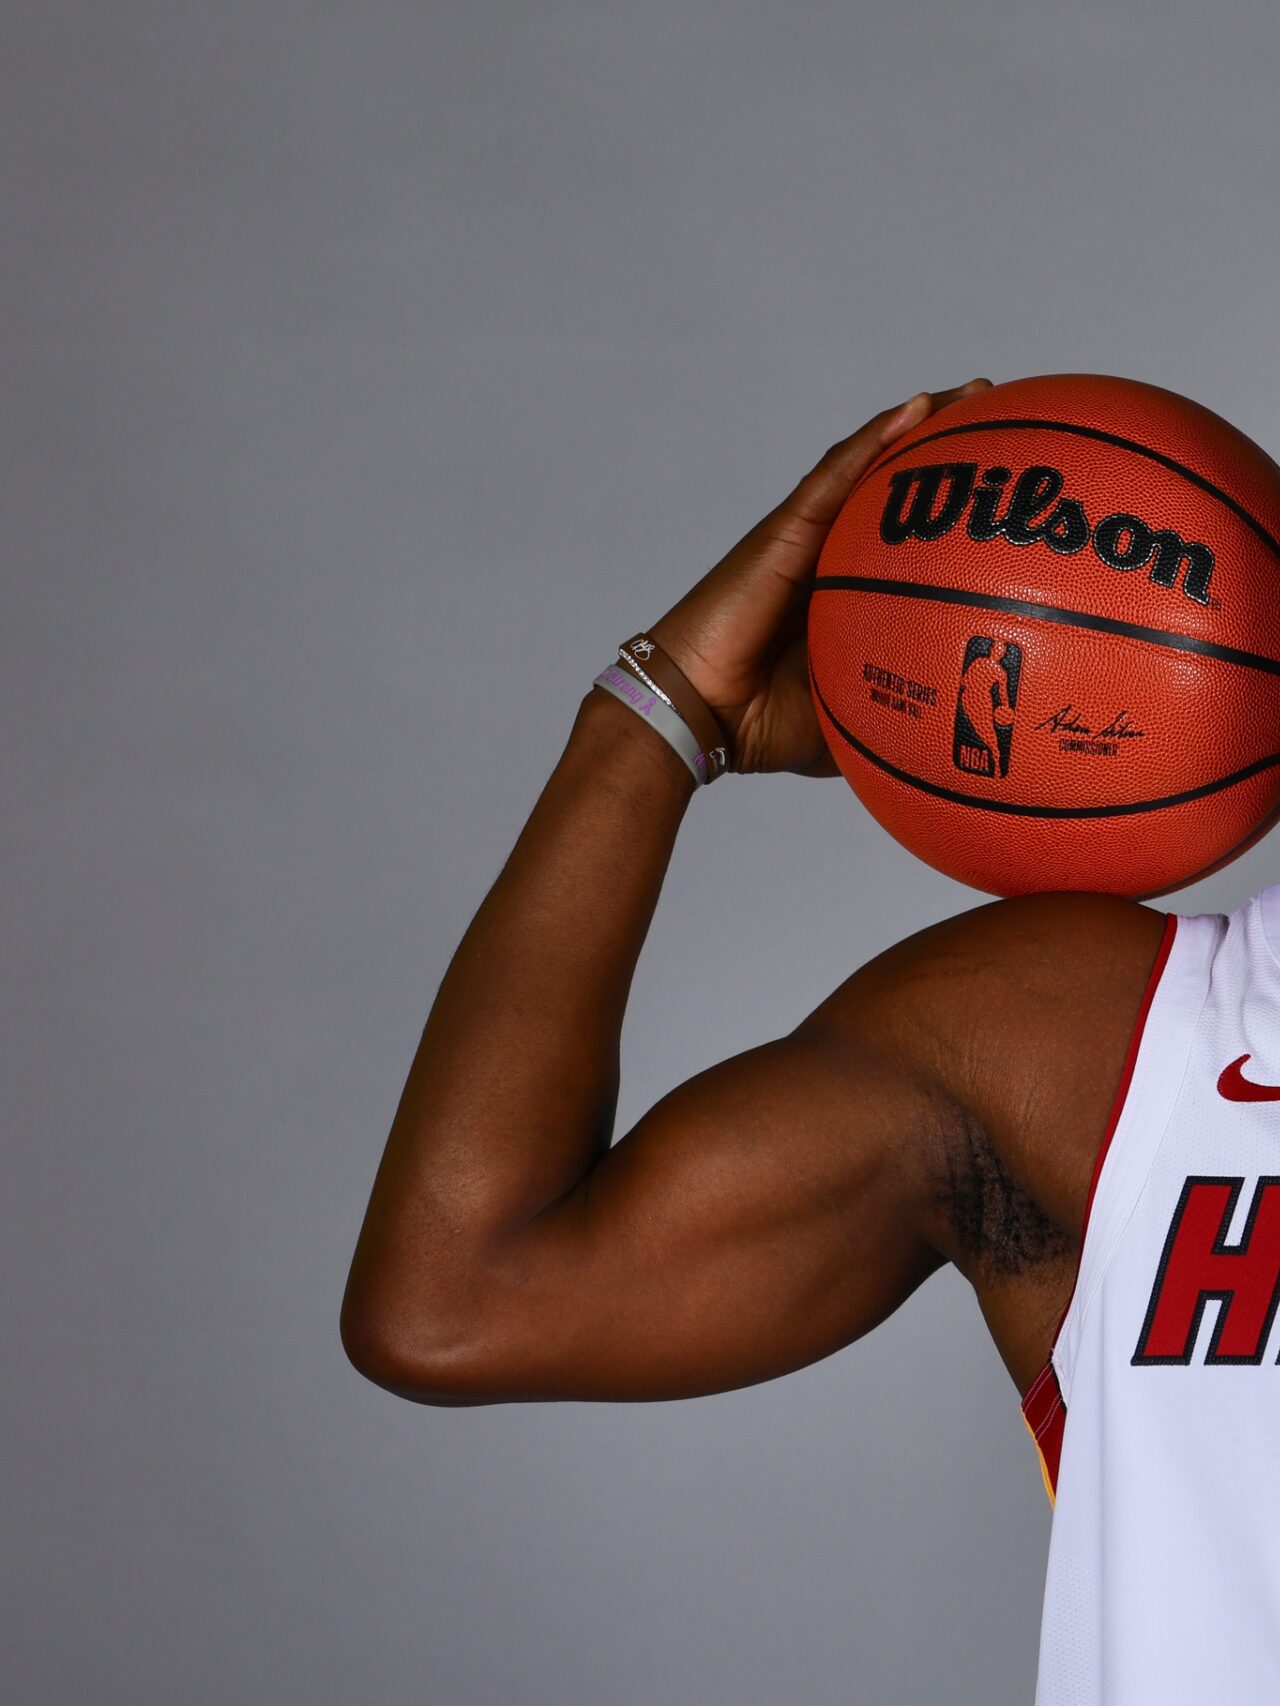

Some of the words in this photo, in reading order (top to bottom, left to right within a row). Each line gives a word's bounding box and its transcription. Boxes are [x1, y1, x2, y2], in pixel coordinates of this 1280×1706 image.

[880, 462, 1216, 606] Wilson
[907, 680, 937, 706] SERIES
[960, 745, 989, 771] NBA
[1060, 739, 1117, 756] COMMISSIONER
